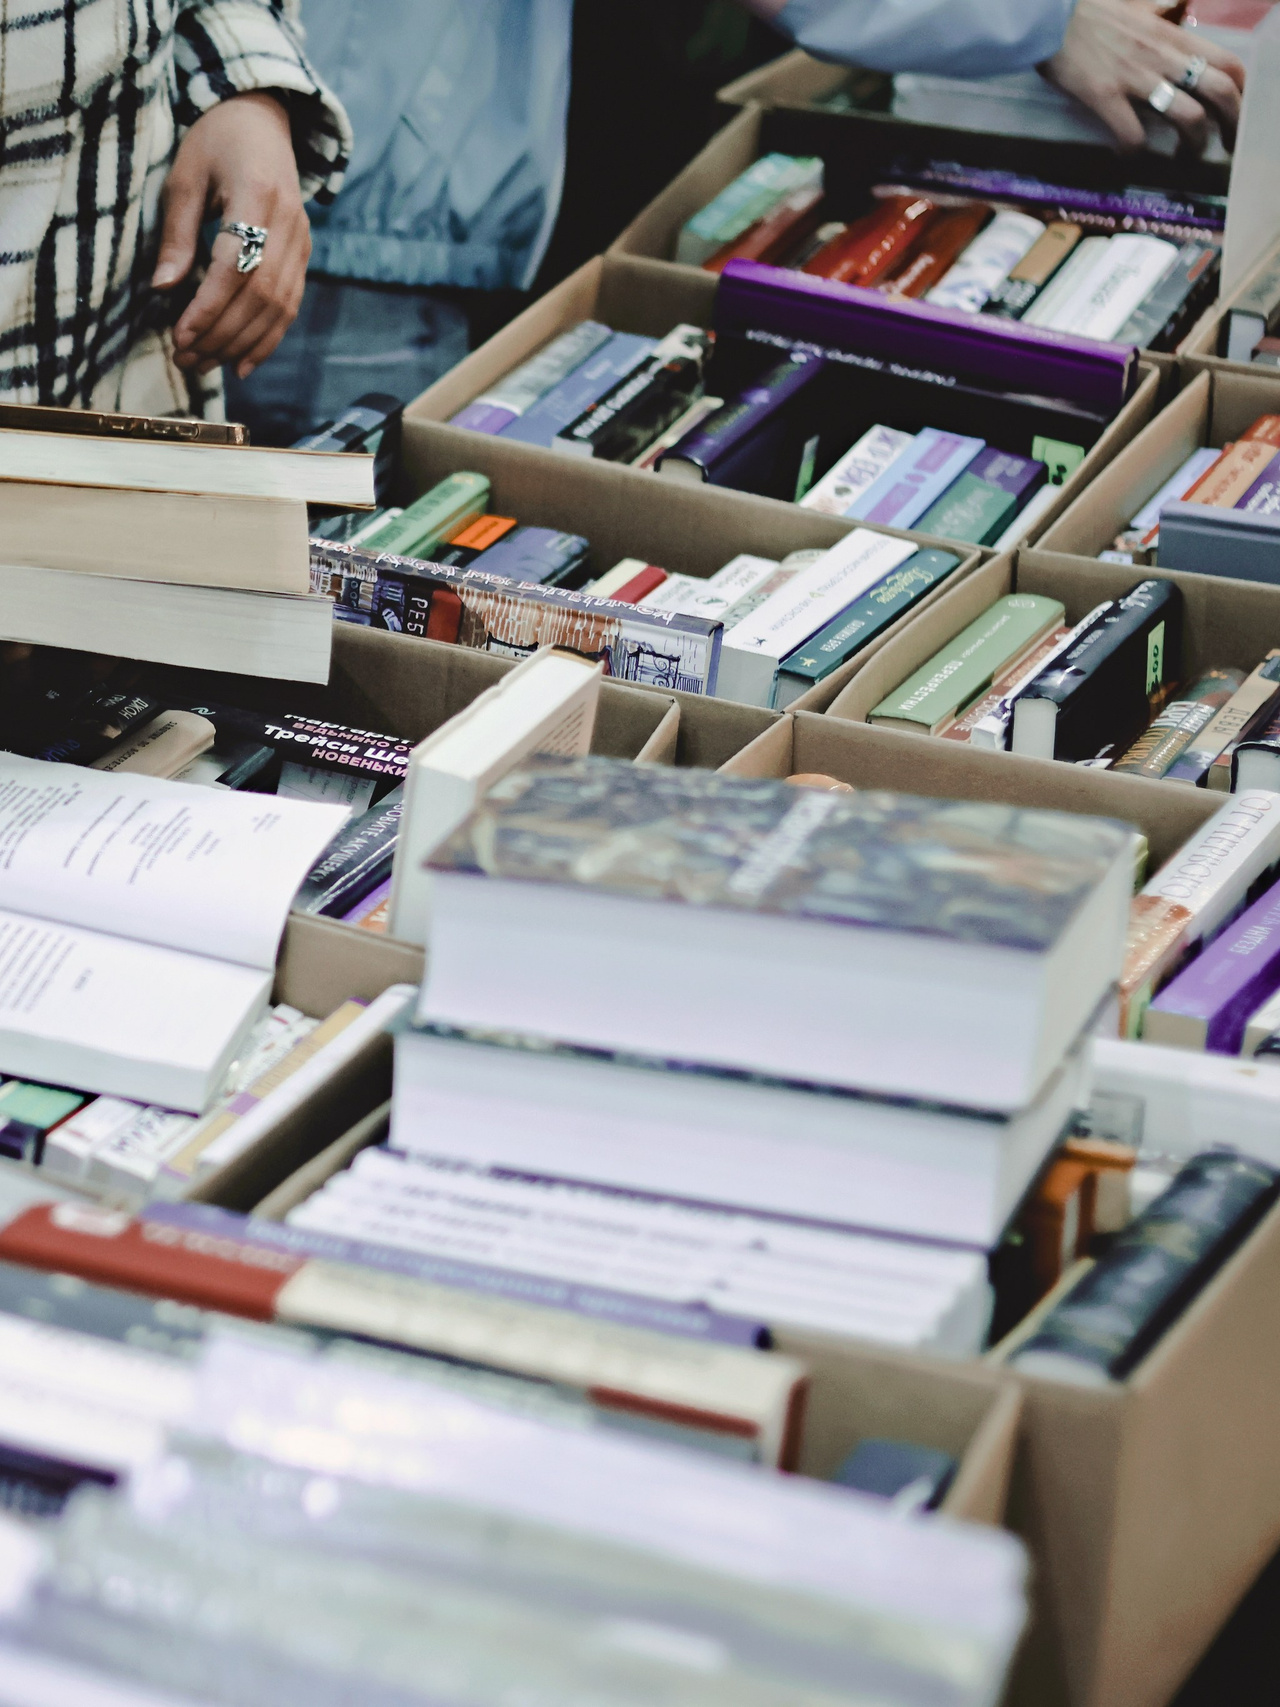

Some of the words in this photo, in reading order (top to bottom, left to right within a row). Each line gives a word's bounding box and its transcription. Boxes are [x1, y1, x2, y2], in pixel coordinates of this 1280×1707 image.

[119, 697, 149, 720] ДЖОН
[1211, 707, 1250, 735] ДЕВЫ
[264, 724, 359, 754] Трейси
[292, 722, 390, 748] ВЕДЬМИНО
[1116, 727, 1170, 765] ГОЛОВА
[311, 748, 409, 778] НОВЕНЬКИ
[360, 799, 405, 838] ЗОВИТЕ
[1230, 797, 1272, 824] ОТ
[308, 837, 369, 882] АКУШЕРКУ
[1159, 822, 1251, 898] ПЕРВОГО
[1228, 925, 1273, 955] БЕЗДНА
